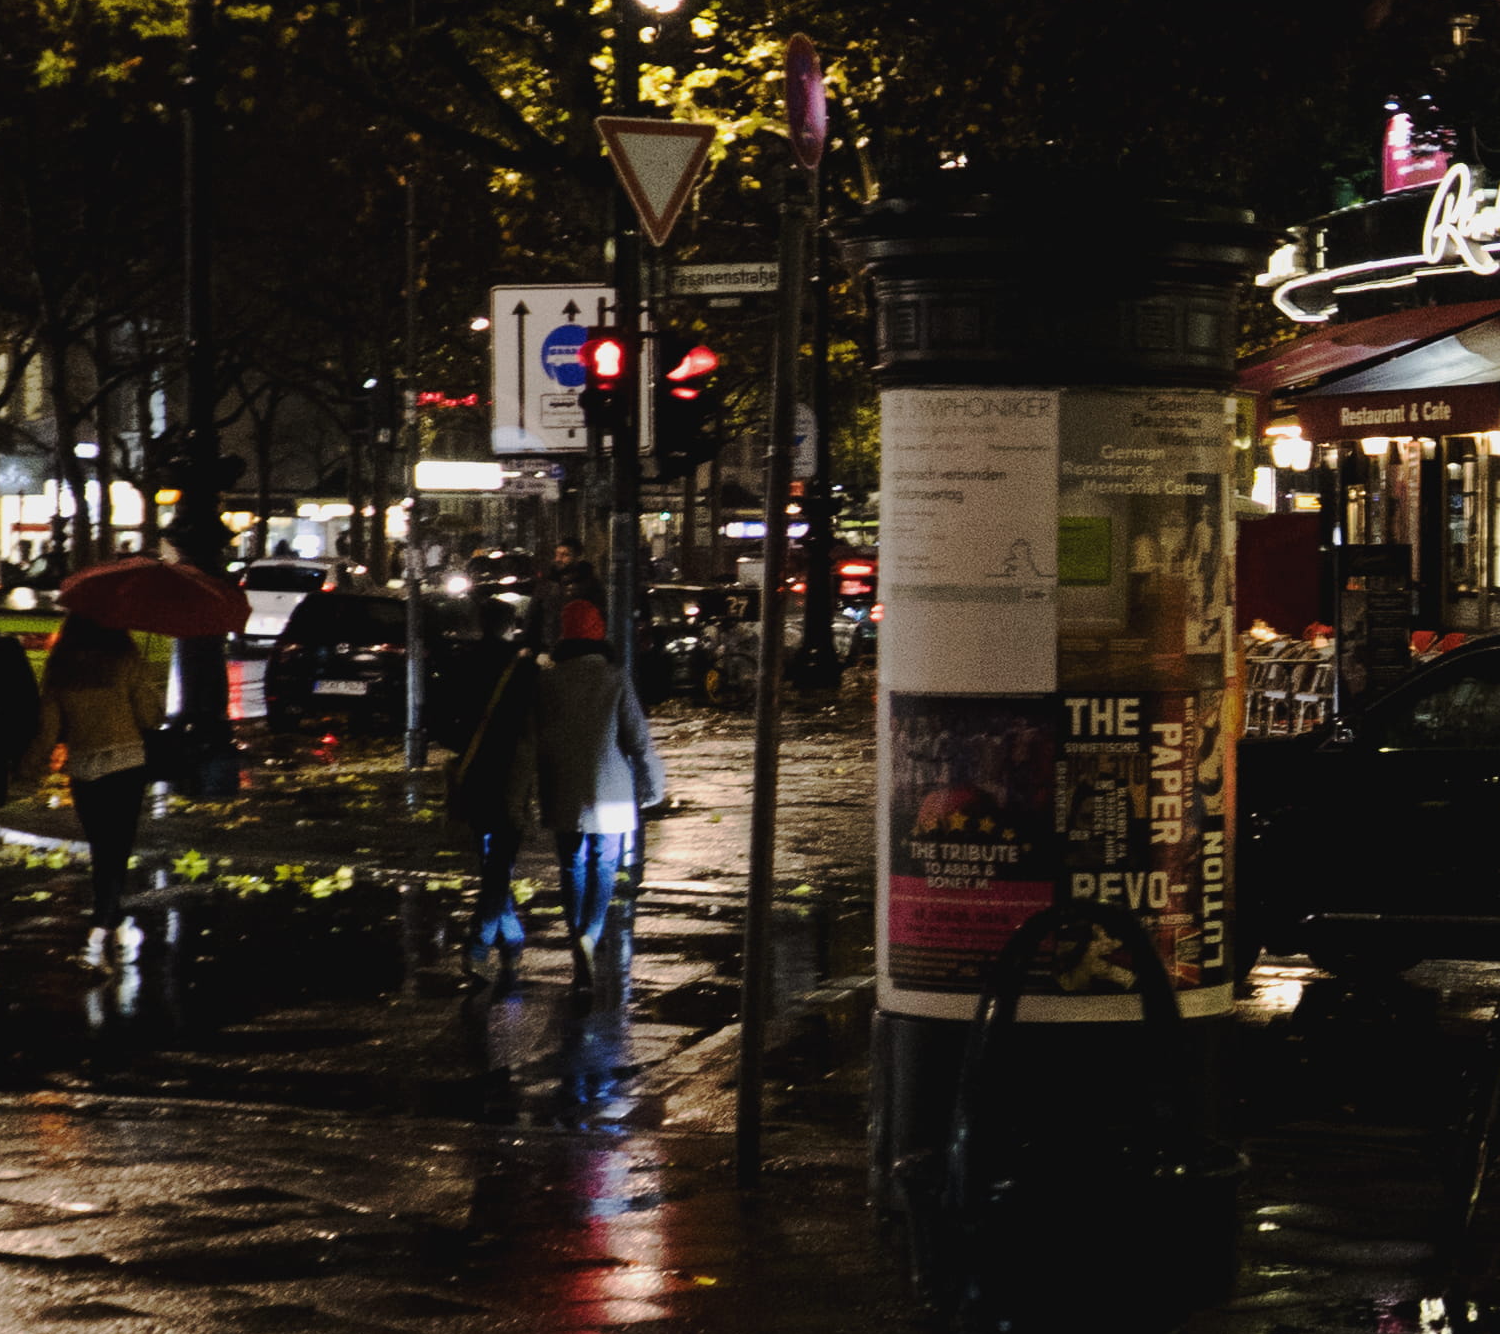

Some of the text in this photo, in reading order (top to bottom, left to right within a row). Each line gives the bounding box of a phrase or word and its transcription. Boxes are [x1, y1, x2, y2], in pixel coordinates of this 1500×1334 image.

[670, 266, 777, 288] Fasanenstraße
[1340, 401, 1452, 427] Restaurant & Cafe
[1100, 444, 1166, 461] German
[1062, 461, 1155, 477] Resistance
[1082, 477, 1208, 497] Memorial Center
[1063, 697, 1141, 737] THE
[1149, 721, 1184, 845] PAPER
[909, 841, 1019, 864] THE TRIBUTE
[924, 861, 996, 877] TO ABBA &
[926, 875, 972, 890] BONEY
[1201, 829, 1225, 969] LUTION
